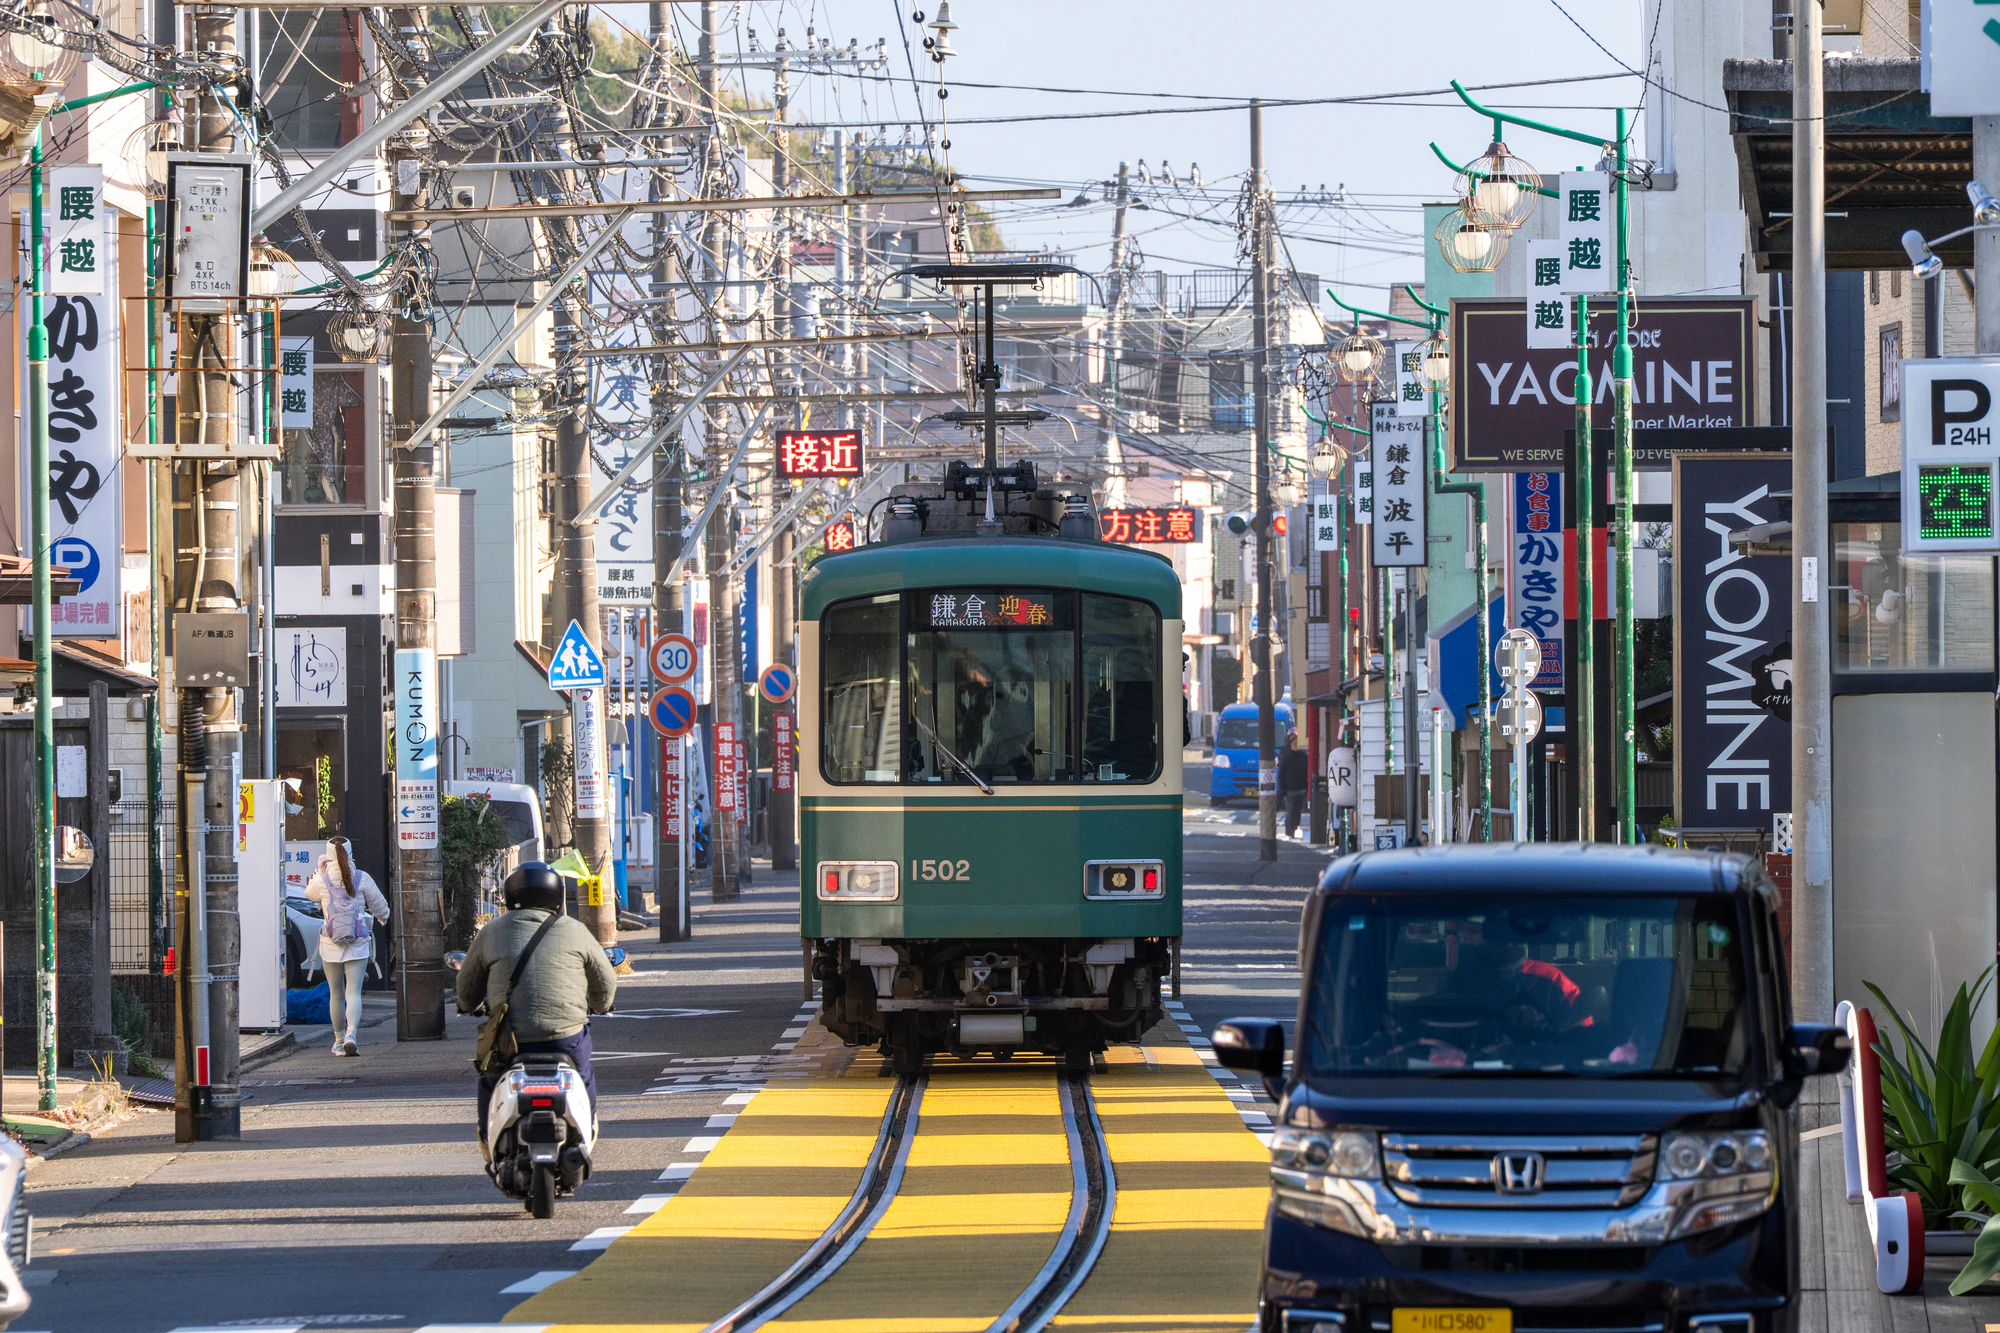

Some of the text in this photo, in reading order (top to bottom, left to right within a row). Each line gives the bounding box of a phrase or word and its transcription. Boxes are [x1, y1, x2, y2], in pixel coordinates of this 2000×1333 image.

[60, 186, 94, 273] 腰越
[1568, 189, 1601, 271] 腰越
[211, 281, 231, 290] 14ch
[1534, 257, 1564, 329] 腰越
[1604, 329, 1661, 348] SORE
[282, 350, 307, 413] 腰越
[1401, 351, 1423, 402] 腰越
[44, 296, 100, 524] かきや
[1931, 379, 1991, 445] P 24H
[781, 434, 858, 473] 接近
[1503, 449, 1524, 461] WE
[1526, 449, 1563, 461] SERVE
[1318, 505, 1334, 541] 腰越
[1384, 443, 1414, 556] 鎌倉波平
[1527, 472, 1550, 531] お食事
[1103, 510, 1195, 541] 方注意
[608, 568, 634, 581] 腰越
[1519, 534, 1559, 637] かきや
[191, 628, 234, 639] AF/軌道JB
[932, 594, 1046, 625] 鎌倉 迎春
[932, 618, 986, 626] KAMAKURA
[661, 648, 688, 671] 30
[1705, 484, 1770, 810] YAOMINE
[406, 671, 427, 762] KUMON
[578, 722, 588, 770] クリニック
[718, 725, 734, 808] 電車に注意
[776, 716, 791, 789] 電車に注意
[400, 831, 436, 841] 電車にご注意
[911, 859, 971, 882] 1502
